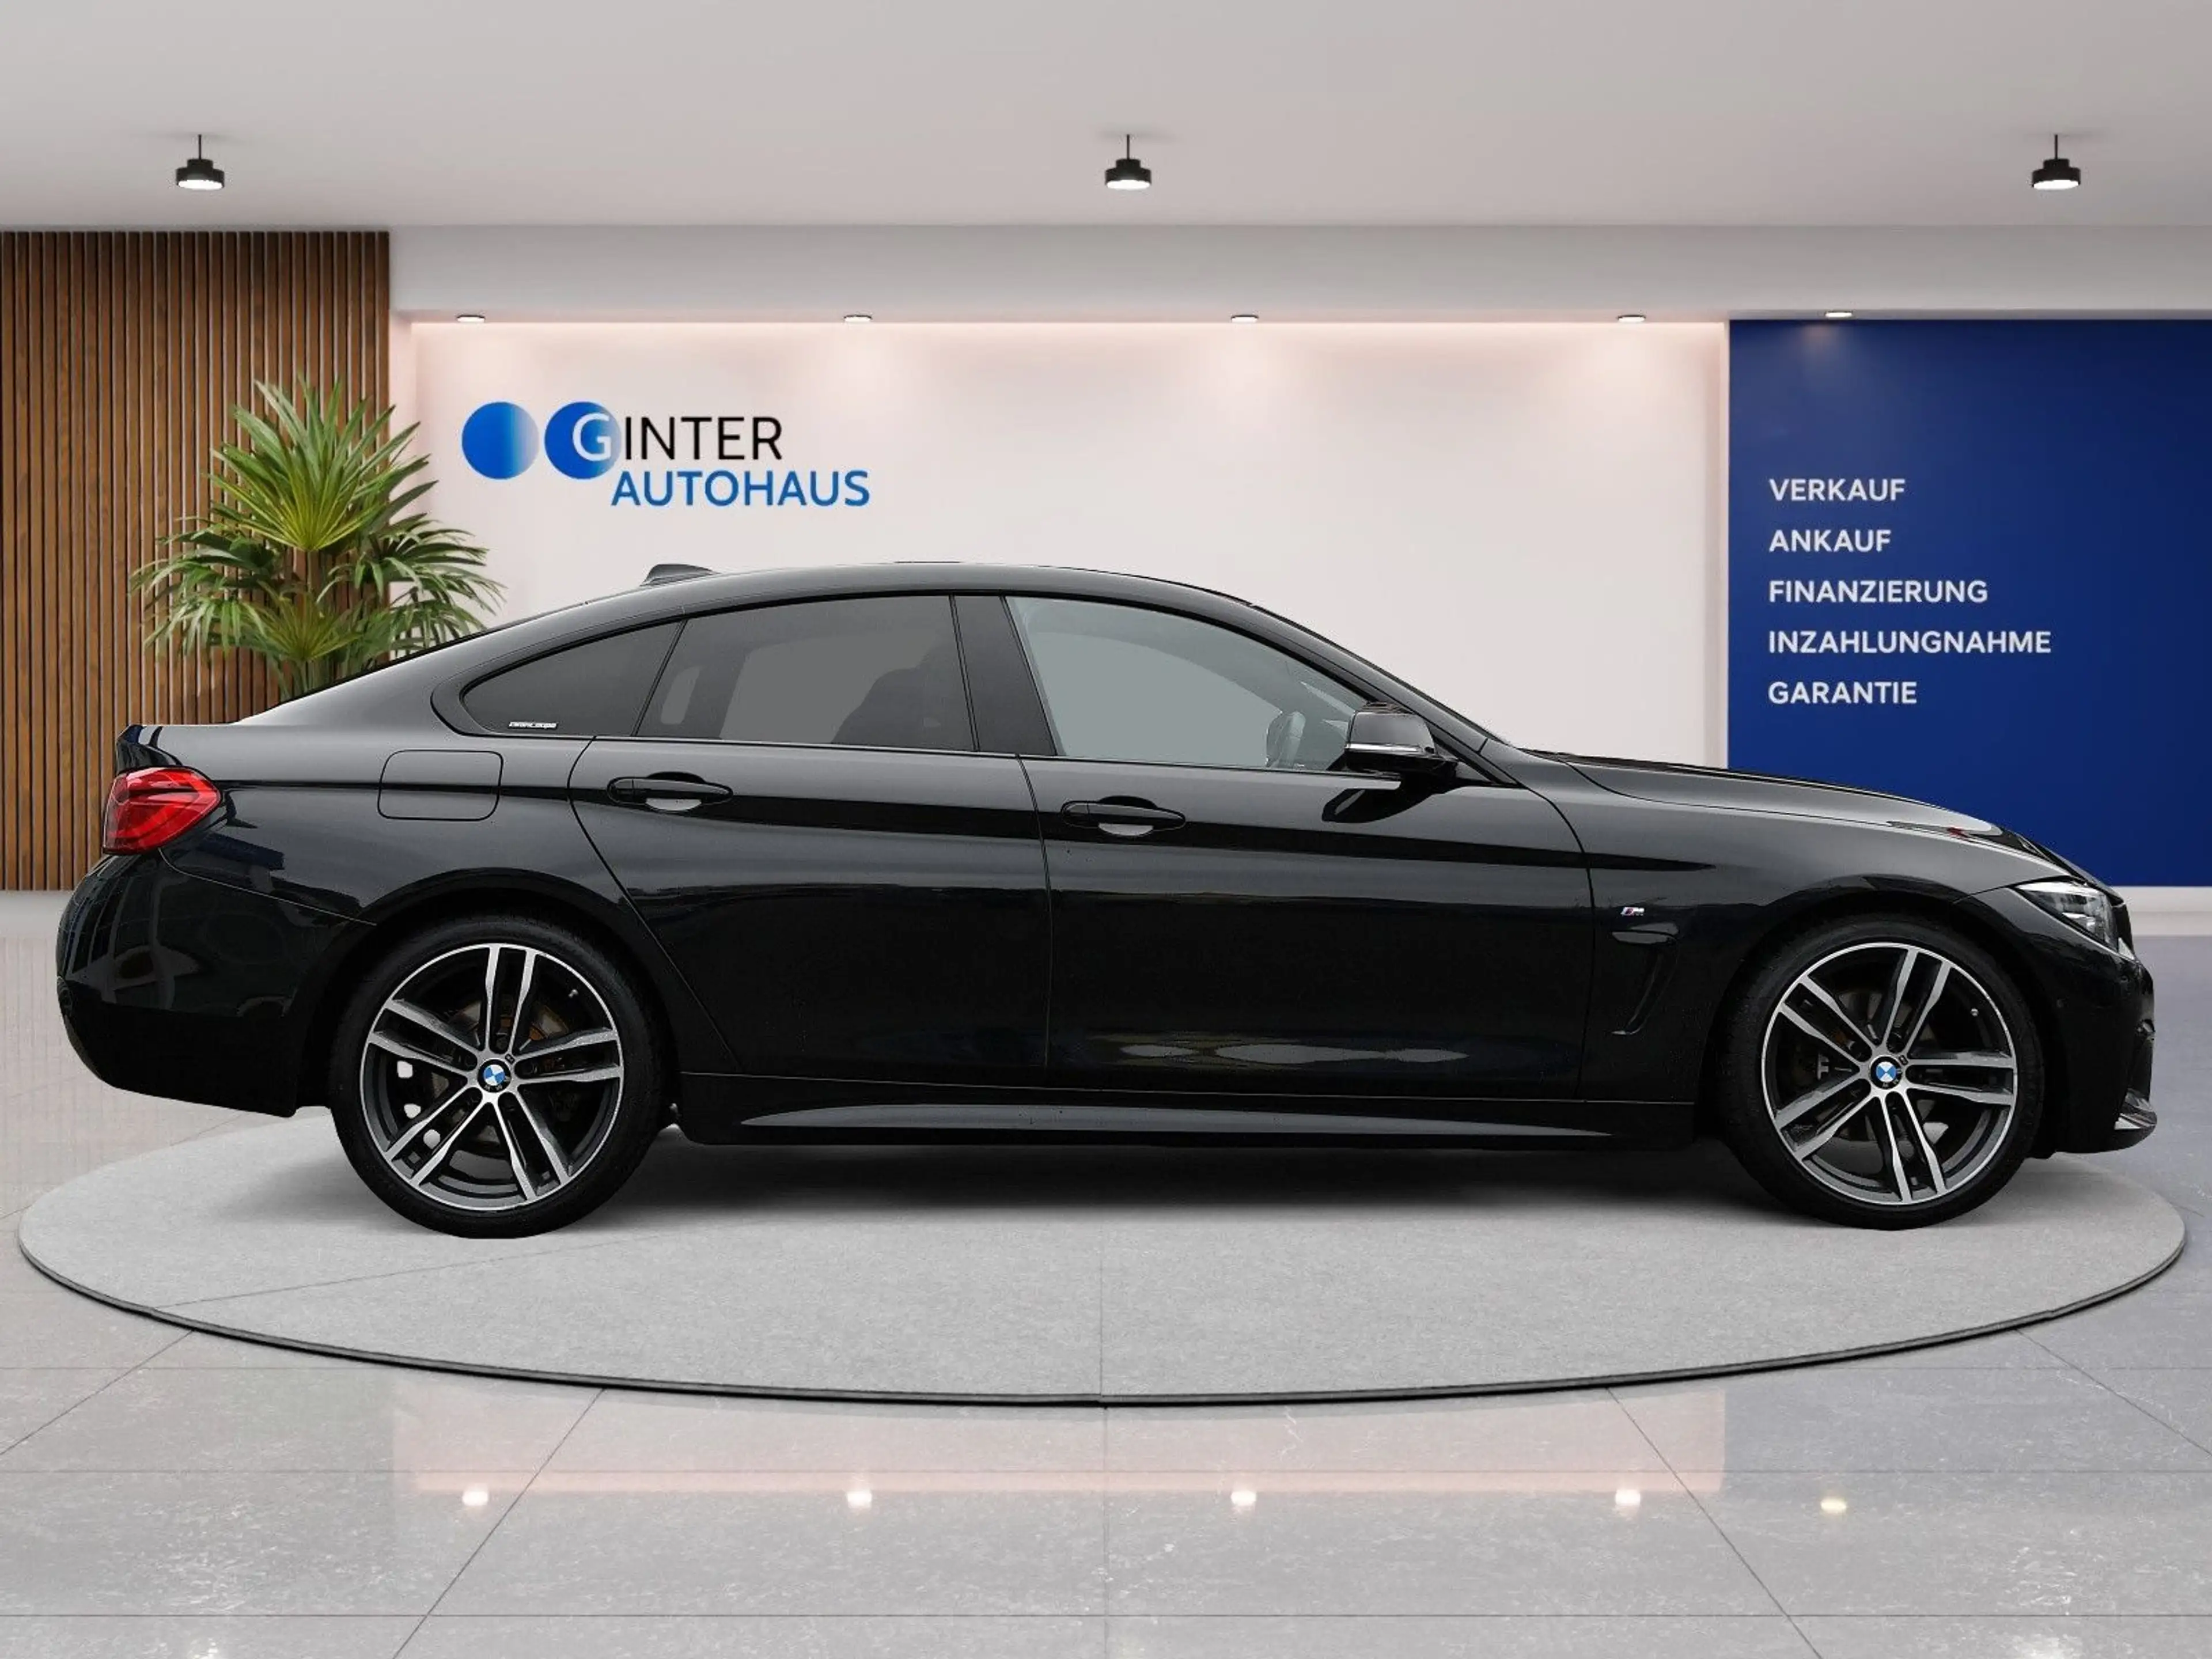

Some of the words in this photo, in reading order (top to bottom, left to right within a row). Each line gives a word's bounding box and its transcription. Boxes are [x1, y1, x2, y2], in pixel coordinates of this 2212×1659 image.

[572, 412, 783, 461] GINTER
[611, 469, 870, 507] AUTOHAUS
[1769, 478, 1905, 501] VERKAUF
[1769, 529, 1891, 552] ANKAUF
[1769, 580, 1987, 603] FINANZIERUNG
[1768, 631, 2051, 653] INZAHLUNGNAHME
[1768, 681, 1917, 704] GARANTIE
